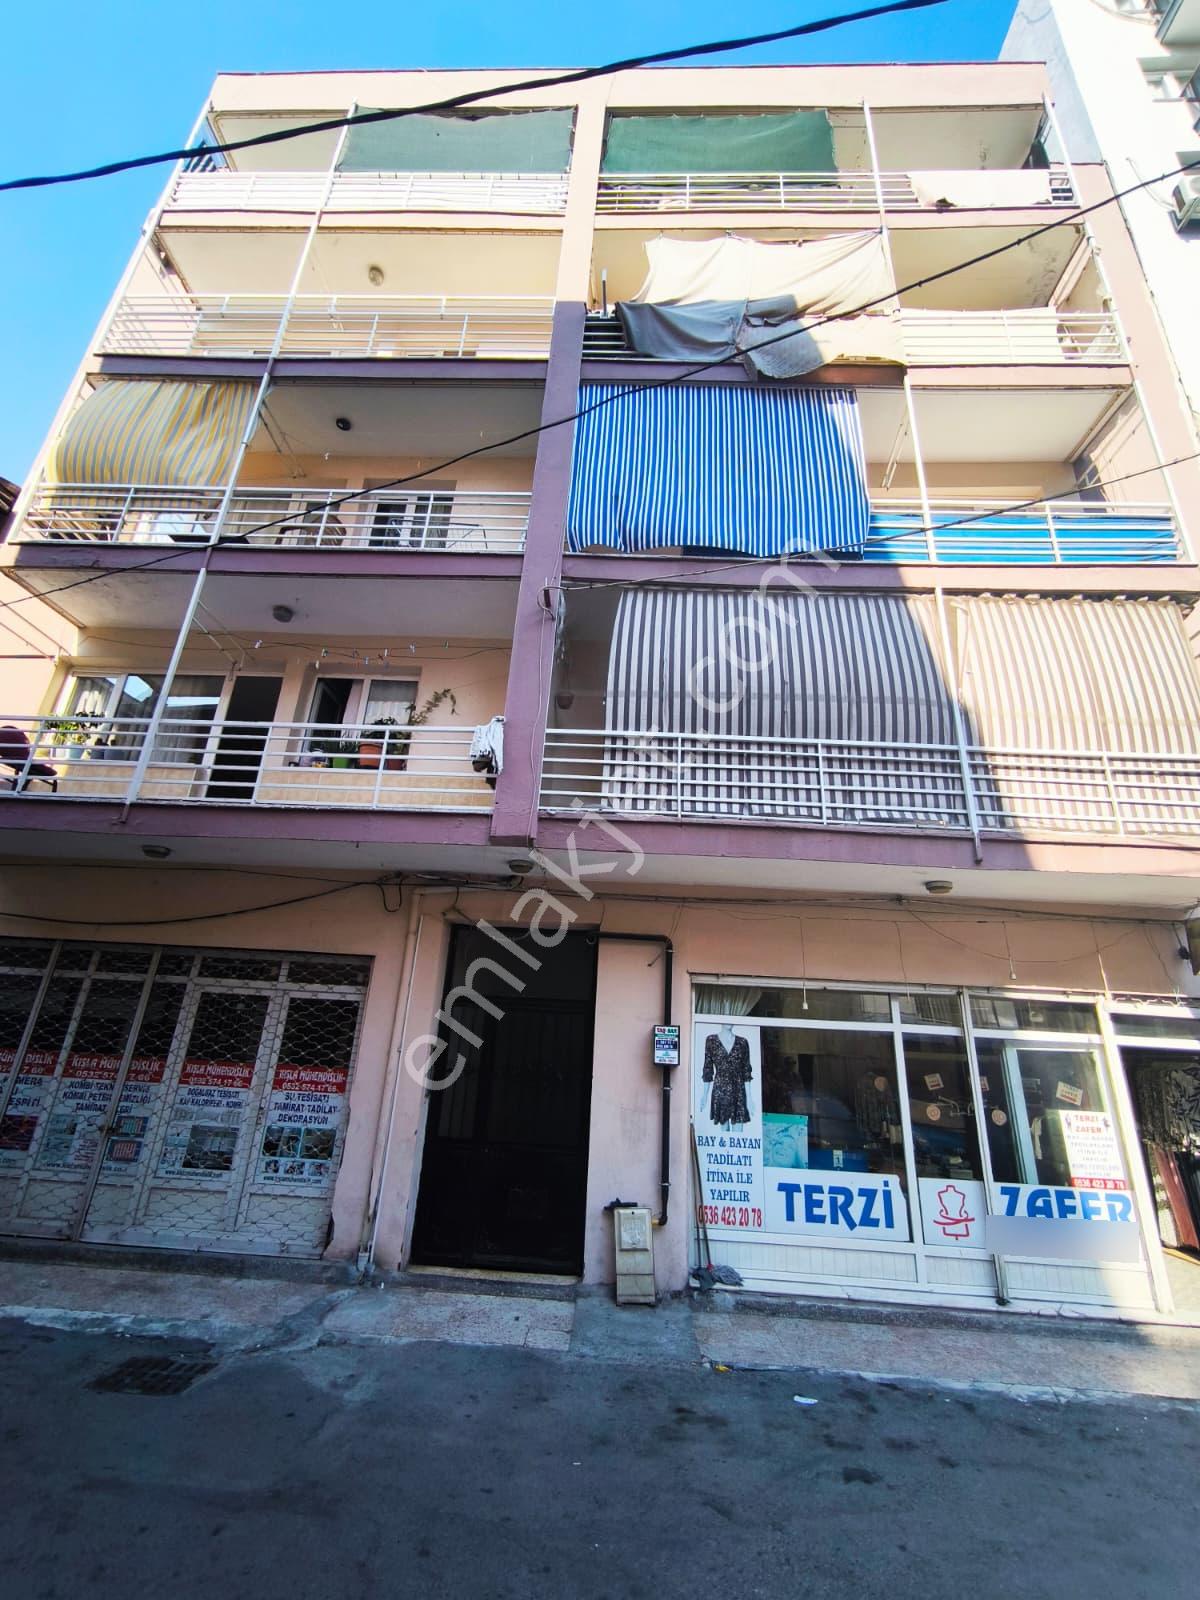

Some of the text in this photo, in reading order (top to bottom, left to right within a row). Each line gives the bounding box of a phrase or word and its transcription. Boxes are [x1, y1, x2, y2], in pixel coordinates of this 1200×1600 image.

[697, 1135, 761, 1150] BAY & BAYAN
[706, 1151, 753, 1167] TADİLATI
[706, 1167, 753, 1185] İTİNA İLE
[709, 1188, 751, 1202] YAPILIR
[777, 1180, 895, 1231] TERZİ
[720, 1206, 737, 1226] 423
[738, 1207, 750, 1227] 20
[751, 1208, 762, 1228] 78
